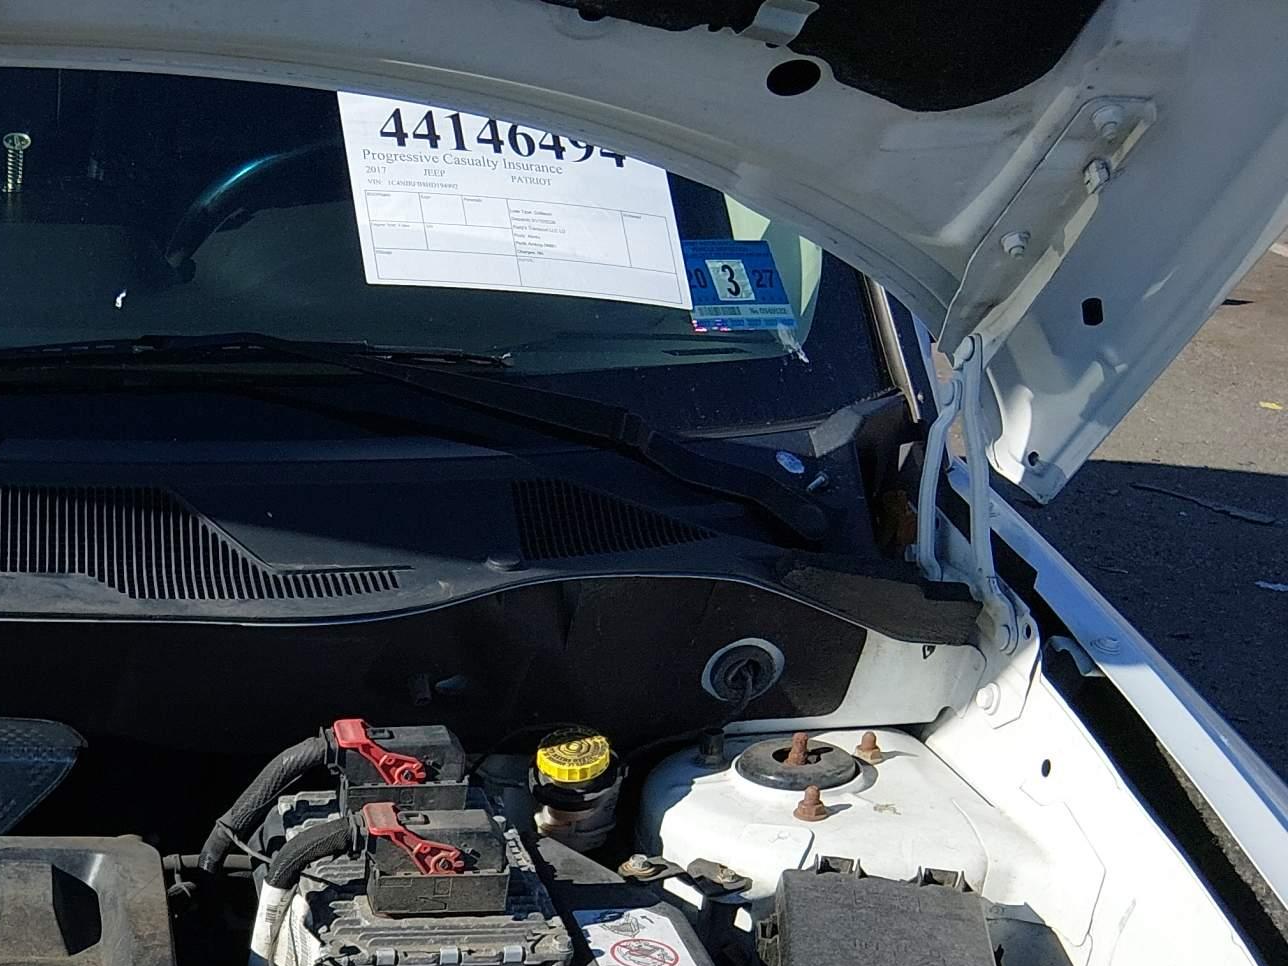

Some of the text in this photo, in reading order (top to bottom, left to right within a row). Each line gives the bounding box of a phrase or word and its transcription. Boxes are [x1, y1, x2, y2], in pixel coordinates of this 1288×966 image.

[362, 149, 563, 175] Progressive Casualty Insurance
[365, 166, 552, 186] 2017 JEEP PATRIOT
[721, 265, 741, 296] 3
[753, 269, 774, 289] 27
